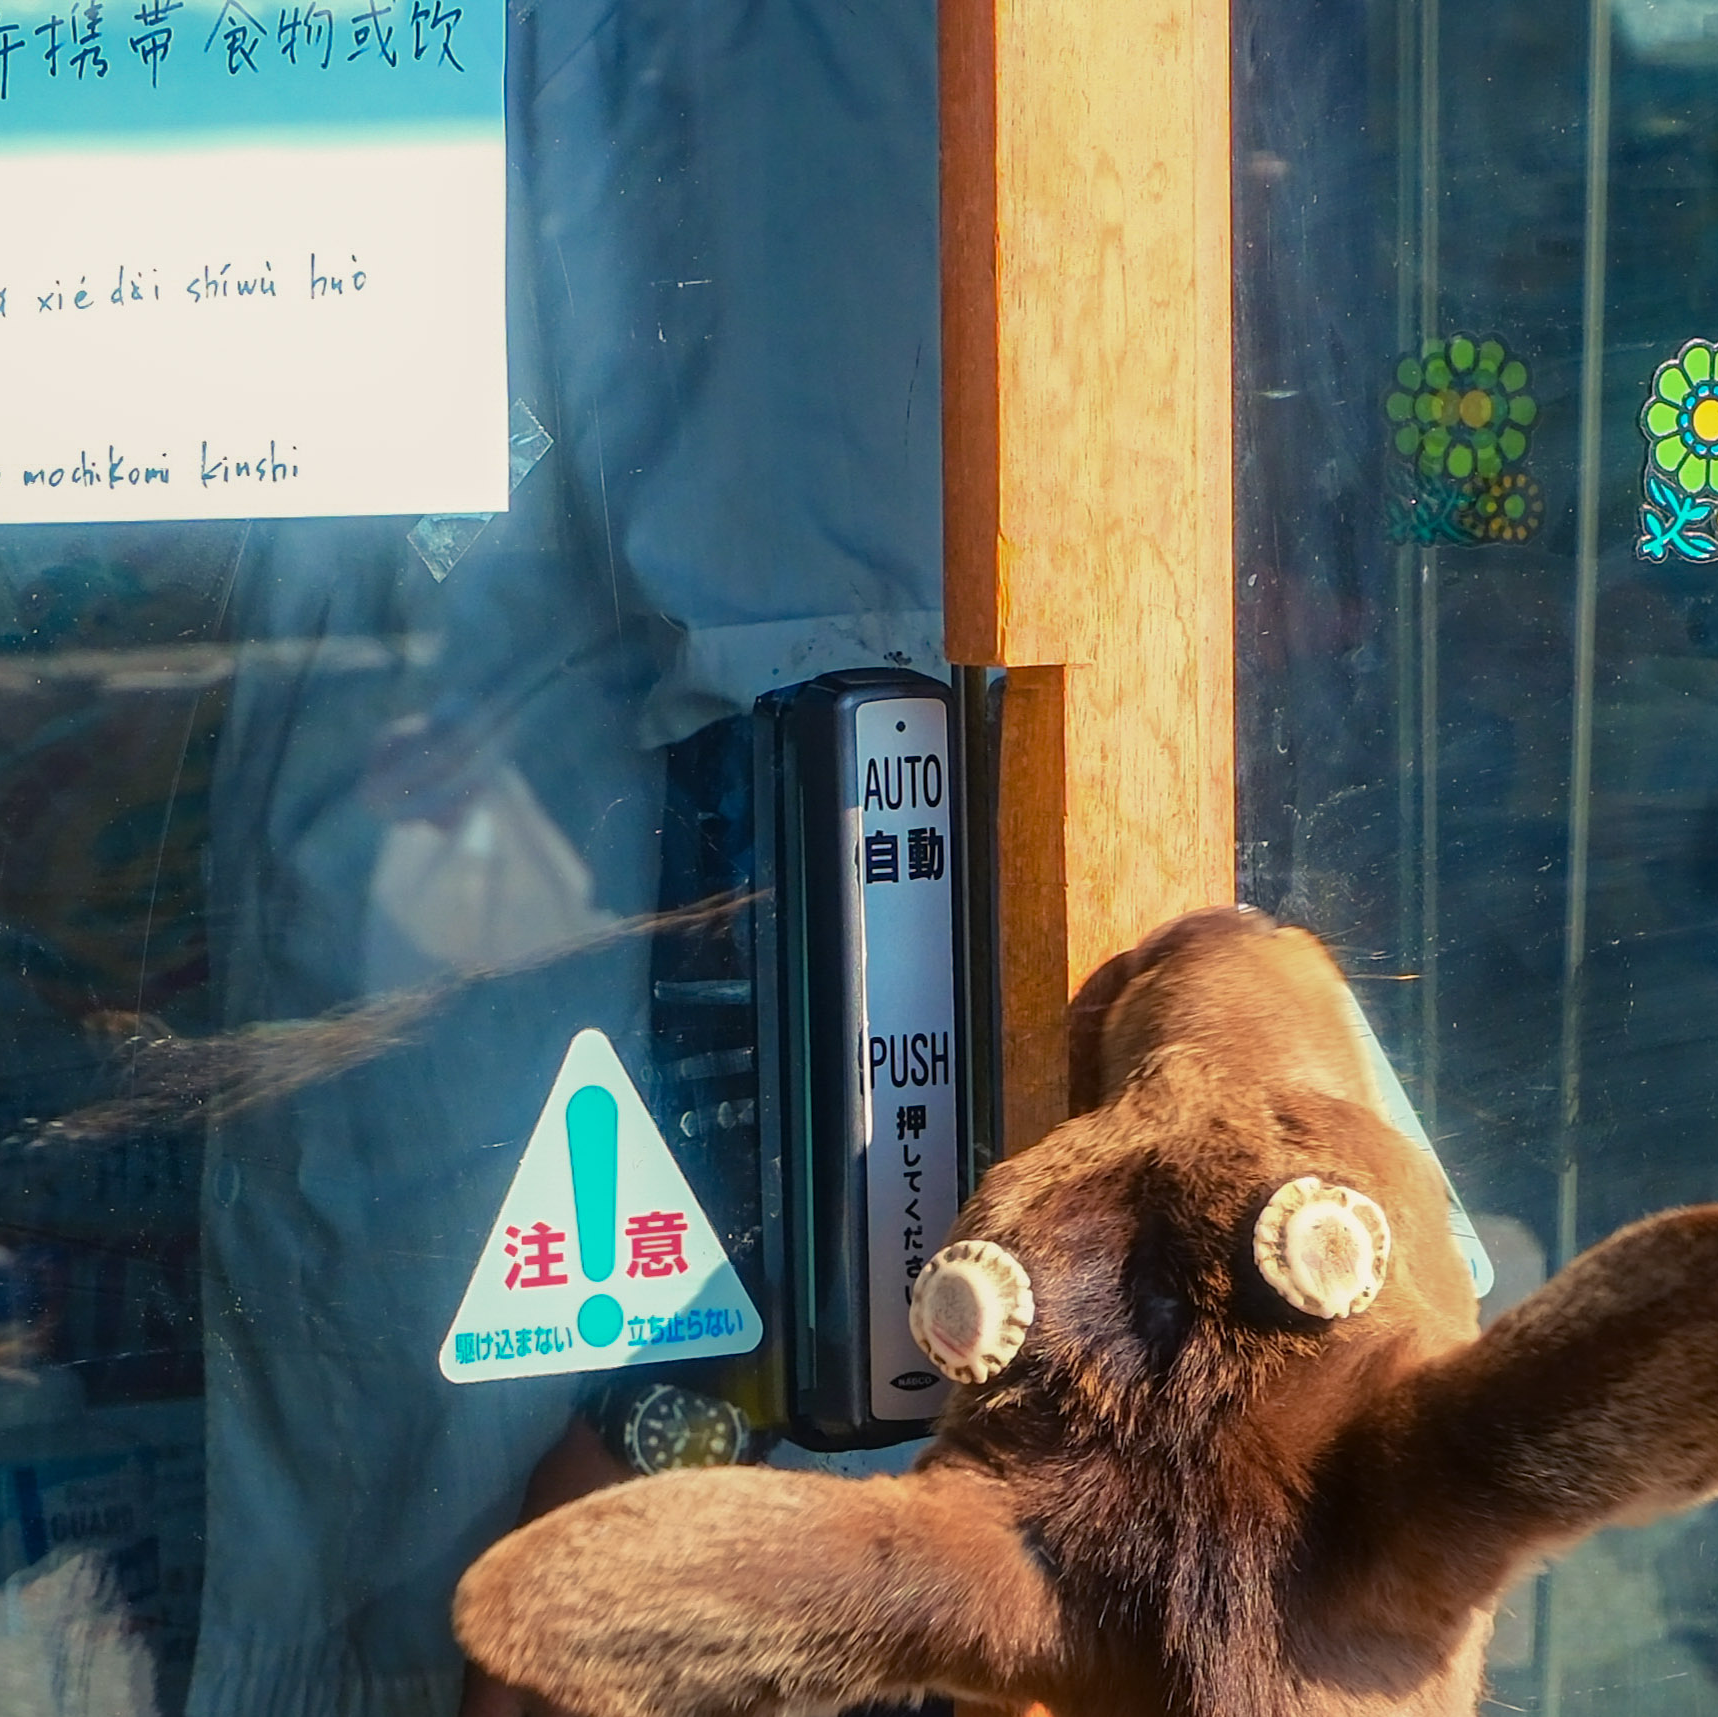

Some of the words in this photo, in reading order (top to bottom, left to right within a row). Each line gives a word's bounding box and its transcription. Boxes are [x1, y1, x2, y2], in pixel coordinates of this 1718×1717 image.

[200, 438, 299, 488] kinshi
[863, 754, 943, 812] AUTO
[864, 827, 945, 885] 自動
[869, 1031, 951, 1090] PUSH
[455, 1325, 573, 1365] 駆け込まない
[626, 1308, 744, 1347] 立ち止らない
